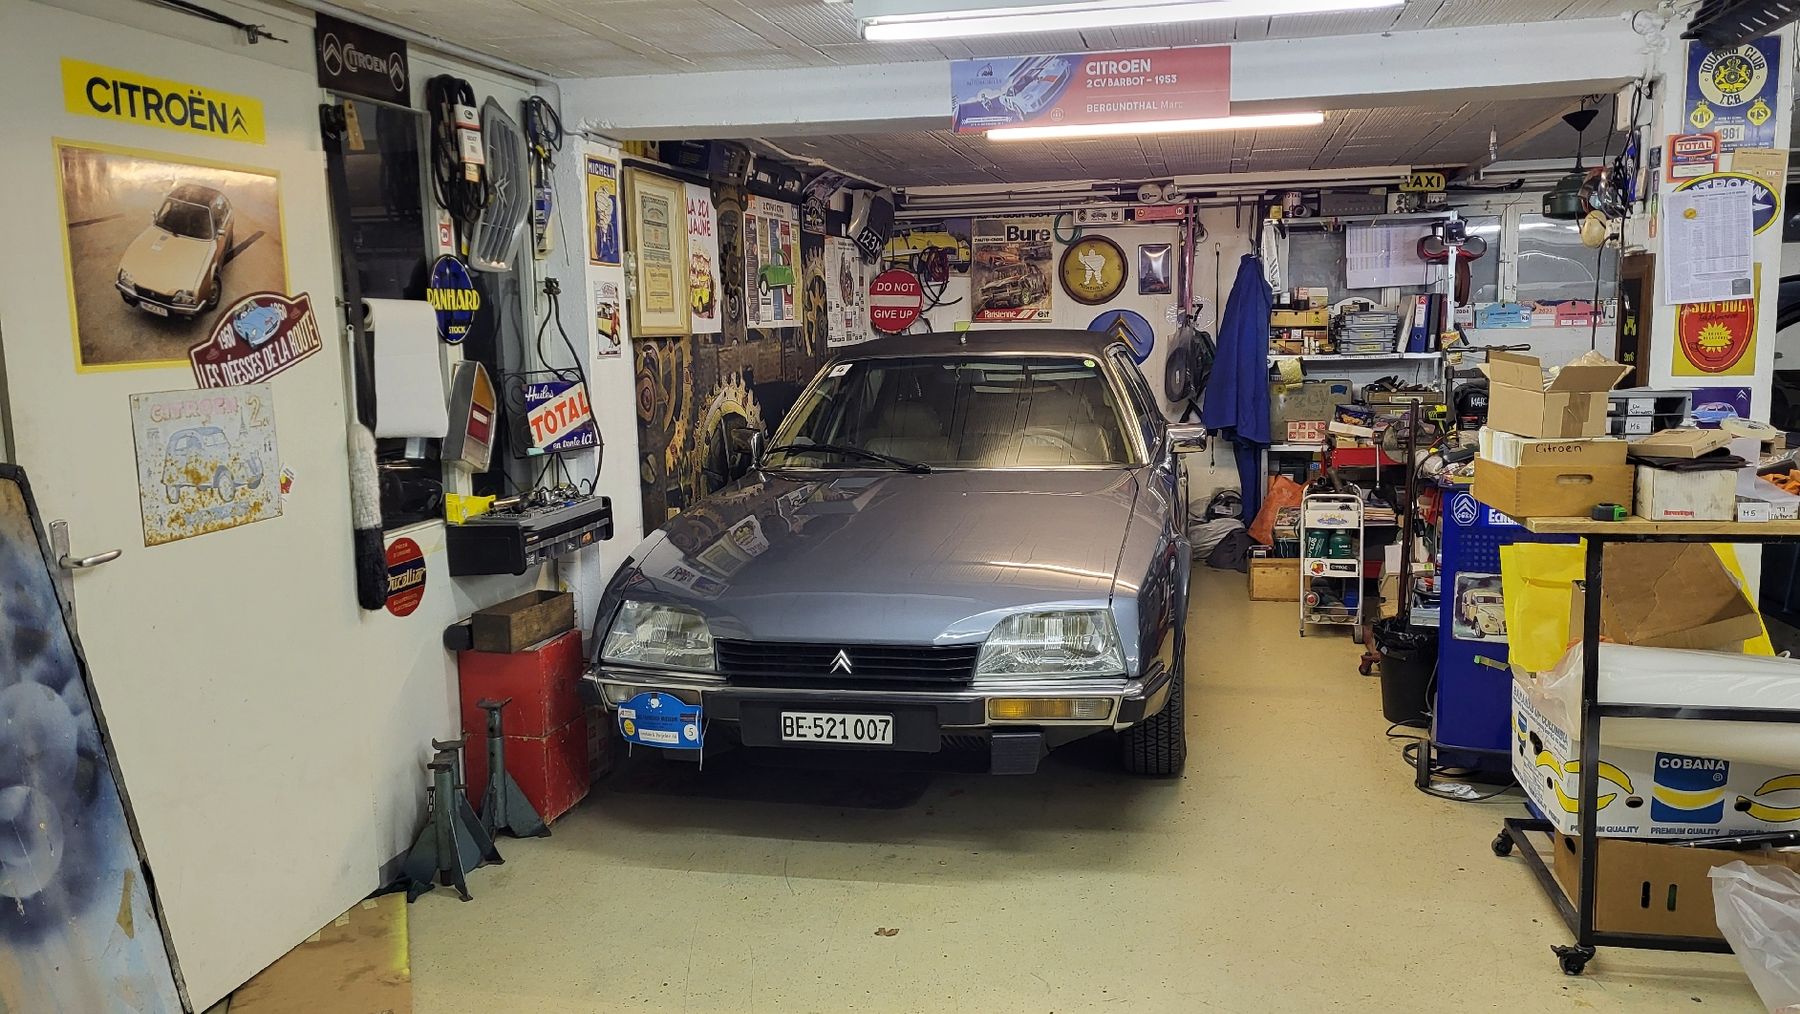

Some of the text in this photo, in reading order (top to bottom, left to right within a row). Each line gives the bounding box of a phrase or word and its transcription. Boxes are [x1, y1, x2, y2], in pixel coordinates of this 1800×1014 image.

[1743, 46, 1766, 71] CLUB
[1085, 58, 1152, 76] CITROEN
[1154, 74, 1177, 85] 1953
[86, 76, 229, 135] CITROËN
[1160, 100, 1183, 110] Marc
[1678, 141, 1713, 151] TOTAL
[1404, 175, 1442, 188] TAXI
[1006, 225, 1051, 242] Bure
[876, 282, 915, 292] DO NOT
[426, 287, 480, 311] PANHARD
[873, 309, 913, 319] GIVE UP
[984, 309, 1050, 319] Parisienne elf
[448, 325, 466, 334] STOCK
[199, 363, 224, 390] LES
[262, 344, 279, 372] DE
[275, 335, 292, 364] LA
[287, 309, 319, 357] ROUTE
[525, 384, 554, 402] Huiles
[530, 390, 591, 443] TOTAL
[1535, 443, 1582, 453] Citroen
[688, 727, 694, 737] 5
[853, 718, 891, 741] 007
[1659, 757, 1726, 771] COBANA
[1606, 825, 1640, 834] QUALITY
[1650, 827, 1721, 836] PREMIUM QUALITY
